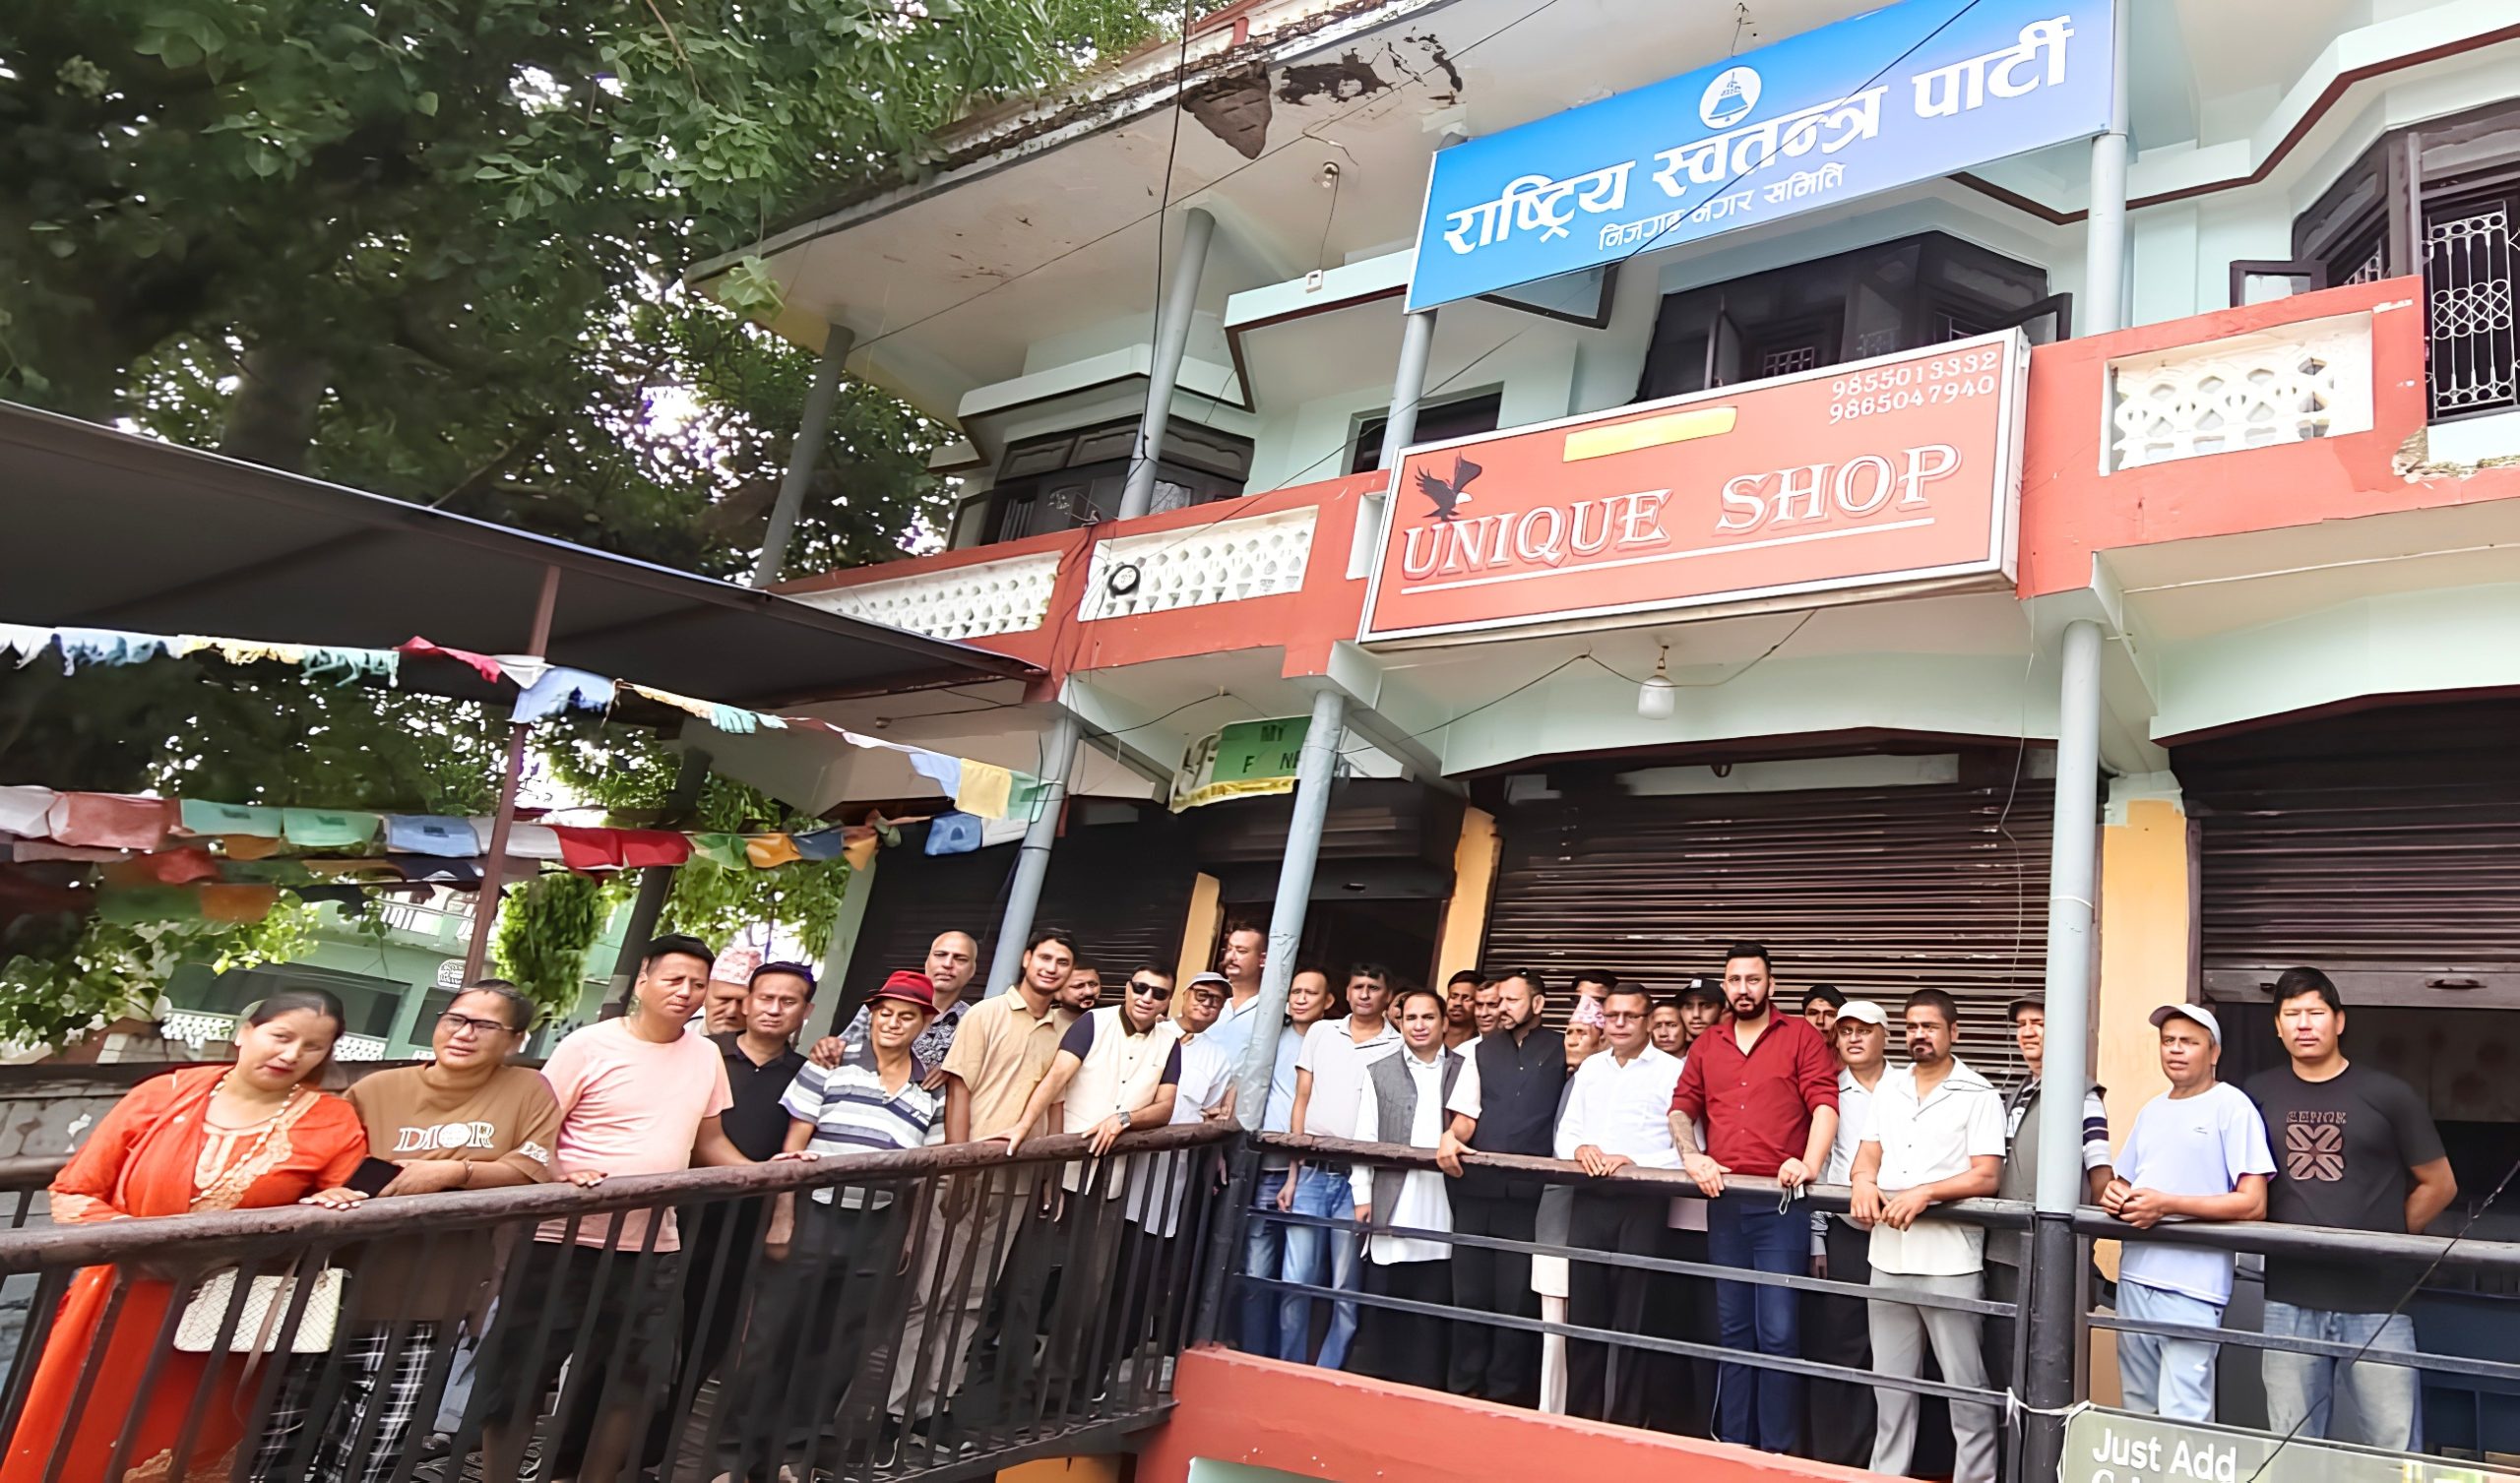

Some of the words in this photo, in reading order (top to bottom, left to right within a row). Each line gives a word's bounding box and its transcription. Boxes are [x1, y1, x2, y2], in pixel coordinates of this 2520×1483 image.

[1443, 159, 1636, 255] राष्ट्रिय
[1653, 86, 1888, 198] स्वतन्त्र
[1911, 15, 2074, 118] पार्टी
[1690, 190, 1755, 224] नगर
[1763, 161, 1847, 204] समिति
[1829, 375, 1995, 425] 9865047940
[1402, 488, 1672, 581] UNIQUE
[1713, 443, 1963, 536] SHOP
[393, 1121, 495, 1152] DIOR
[2092, 1427, 2163, 1472] Just
[2169, 1440, 2236, 1483] Add
